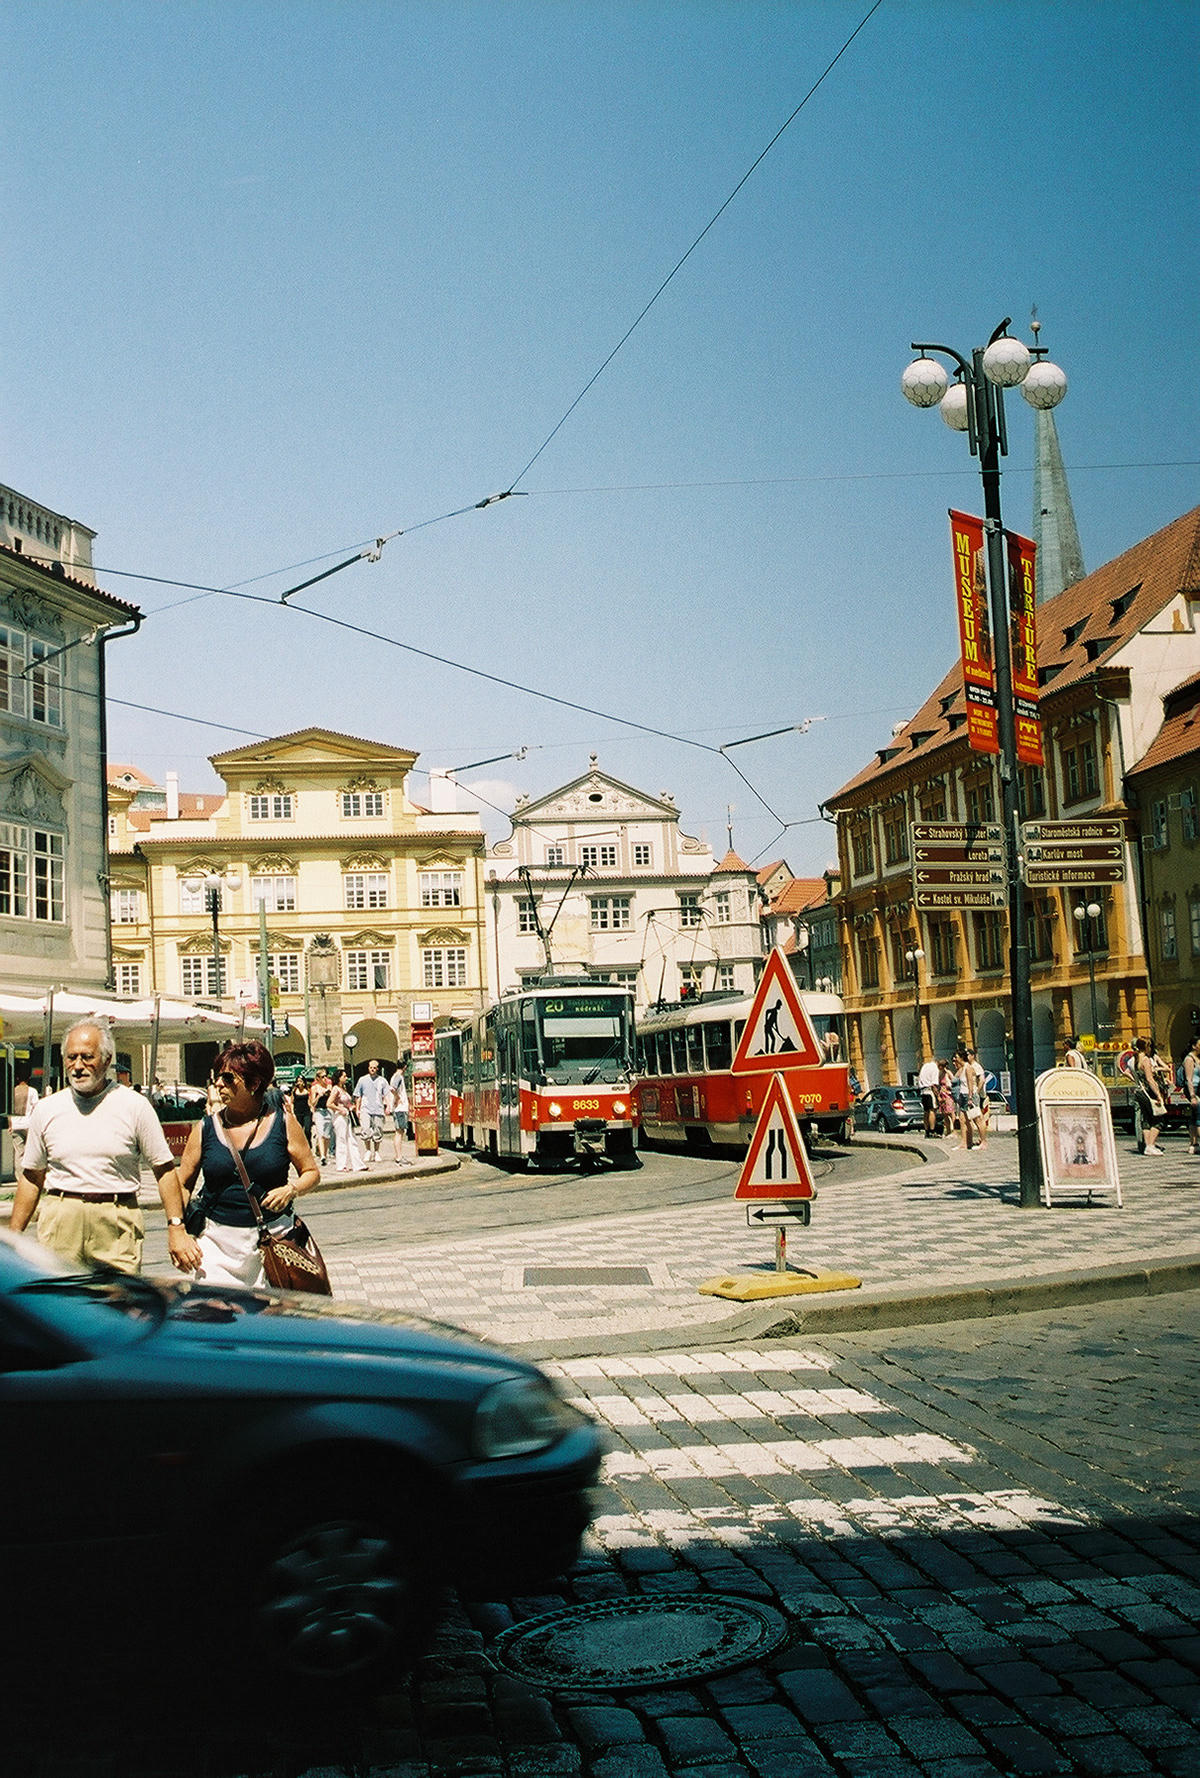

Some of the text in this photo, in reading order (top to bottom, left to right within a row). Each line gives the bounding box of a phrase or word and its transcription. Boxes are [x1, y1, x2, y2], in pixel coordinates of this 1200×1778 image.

[955, 531, 979, 662] MUSEUM
[1021, 557, 1036, 681] TORTURE
[928, 827, 963, 841] Strahovský
[1041, 825, 1103, 838] Staroměstská radnice
[968, 851, 988, 861] Loreta
[1042, 848, 1084, 860] Karlův most
[949, 871, 989, 885] Pražský hrad
[1028, 869, 1096, 881] Turistické informace
[932, 893, 990, 905] Kostel sv. Mikuláše
[545, 1000, 563, 1012] 20
[799, 1093, 822, 1104] 7070
[573, 1100, 600, 1110] 8633
